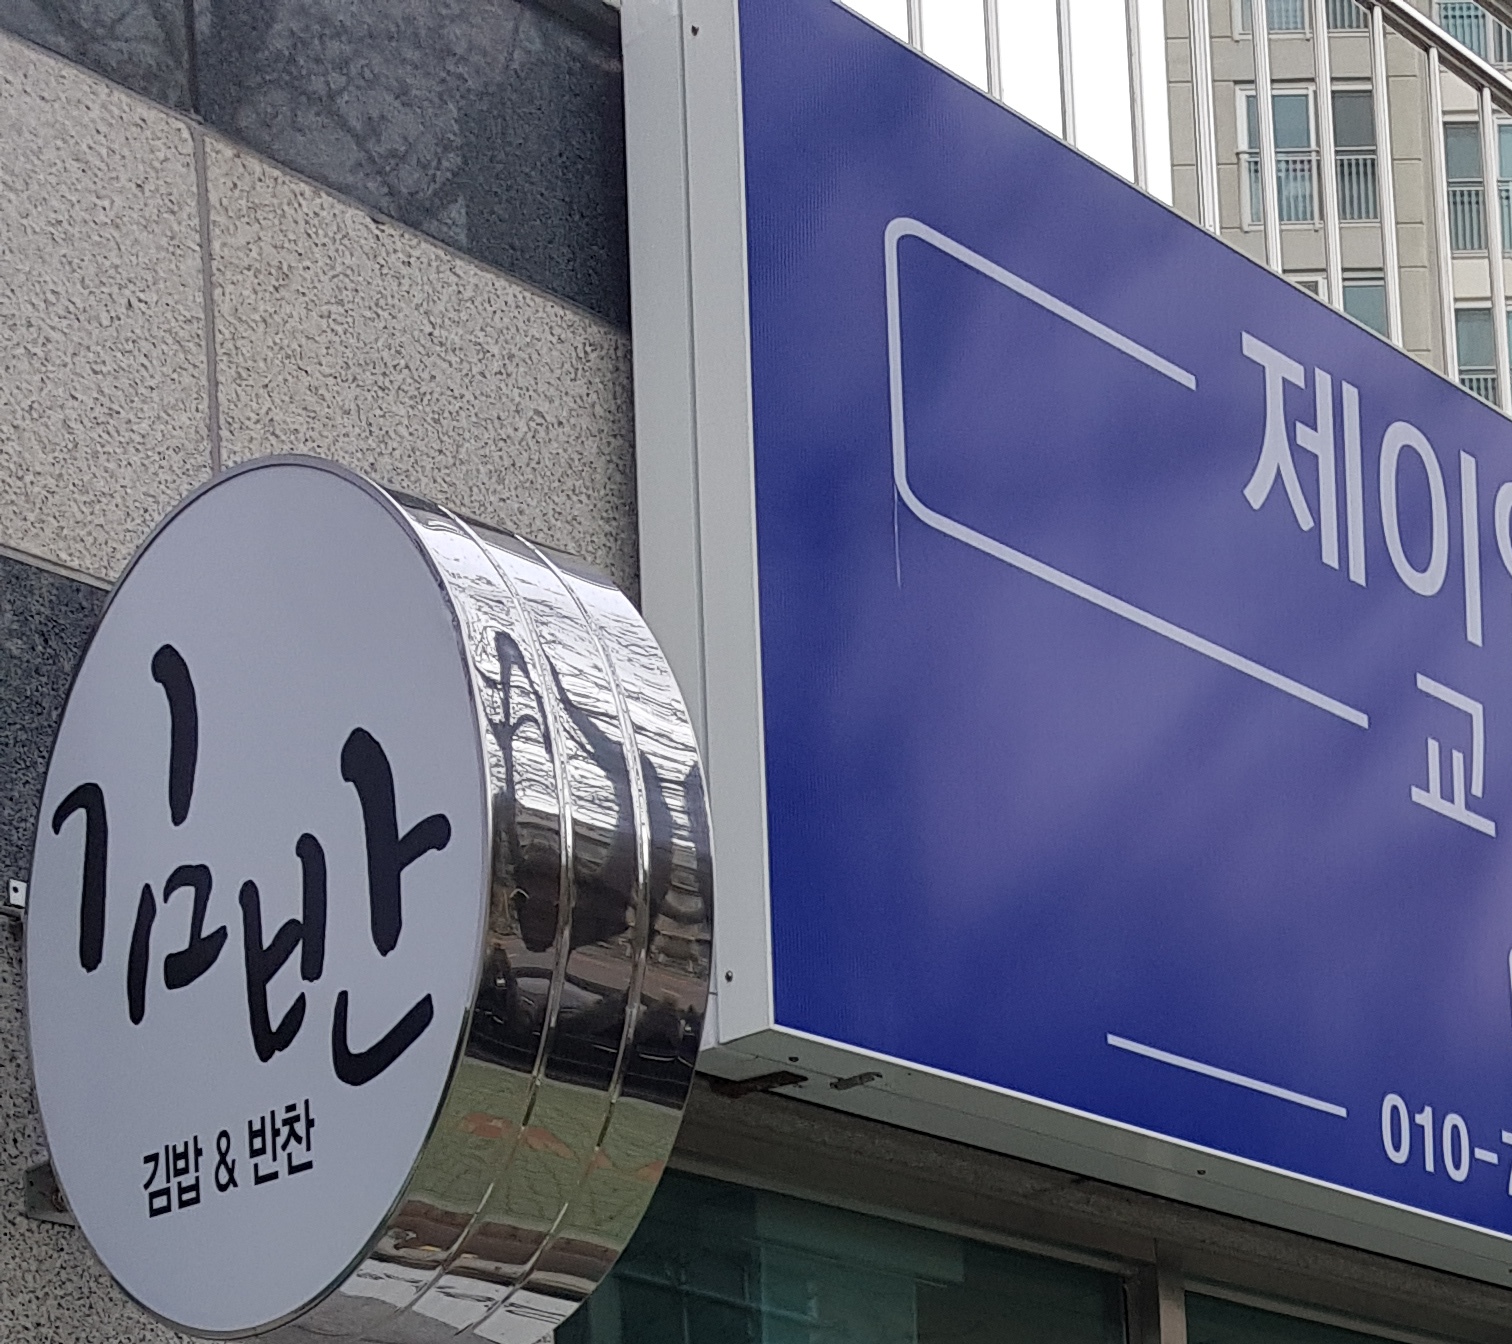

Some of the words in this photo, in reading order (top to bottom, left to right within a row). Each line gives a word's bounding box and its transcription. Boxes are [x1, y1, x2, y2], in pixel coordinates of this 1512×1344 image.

[142, 1133, 203, 1219] 김밥
[213, 1140, 239, 1192] &
[247, 1098, 316, 1187] 반찬
